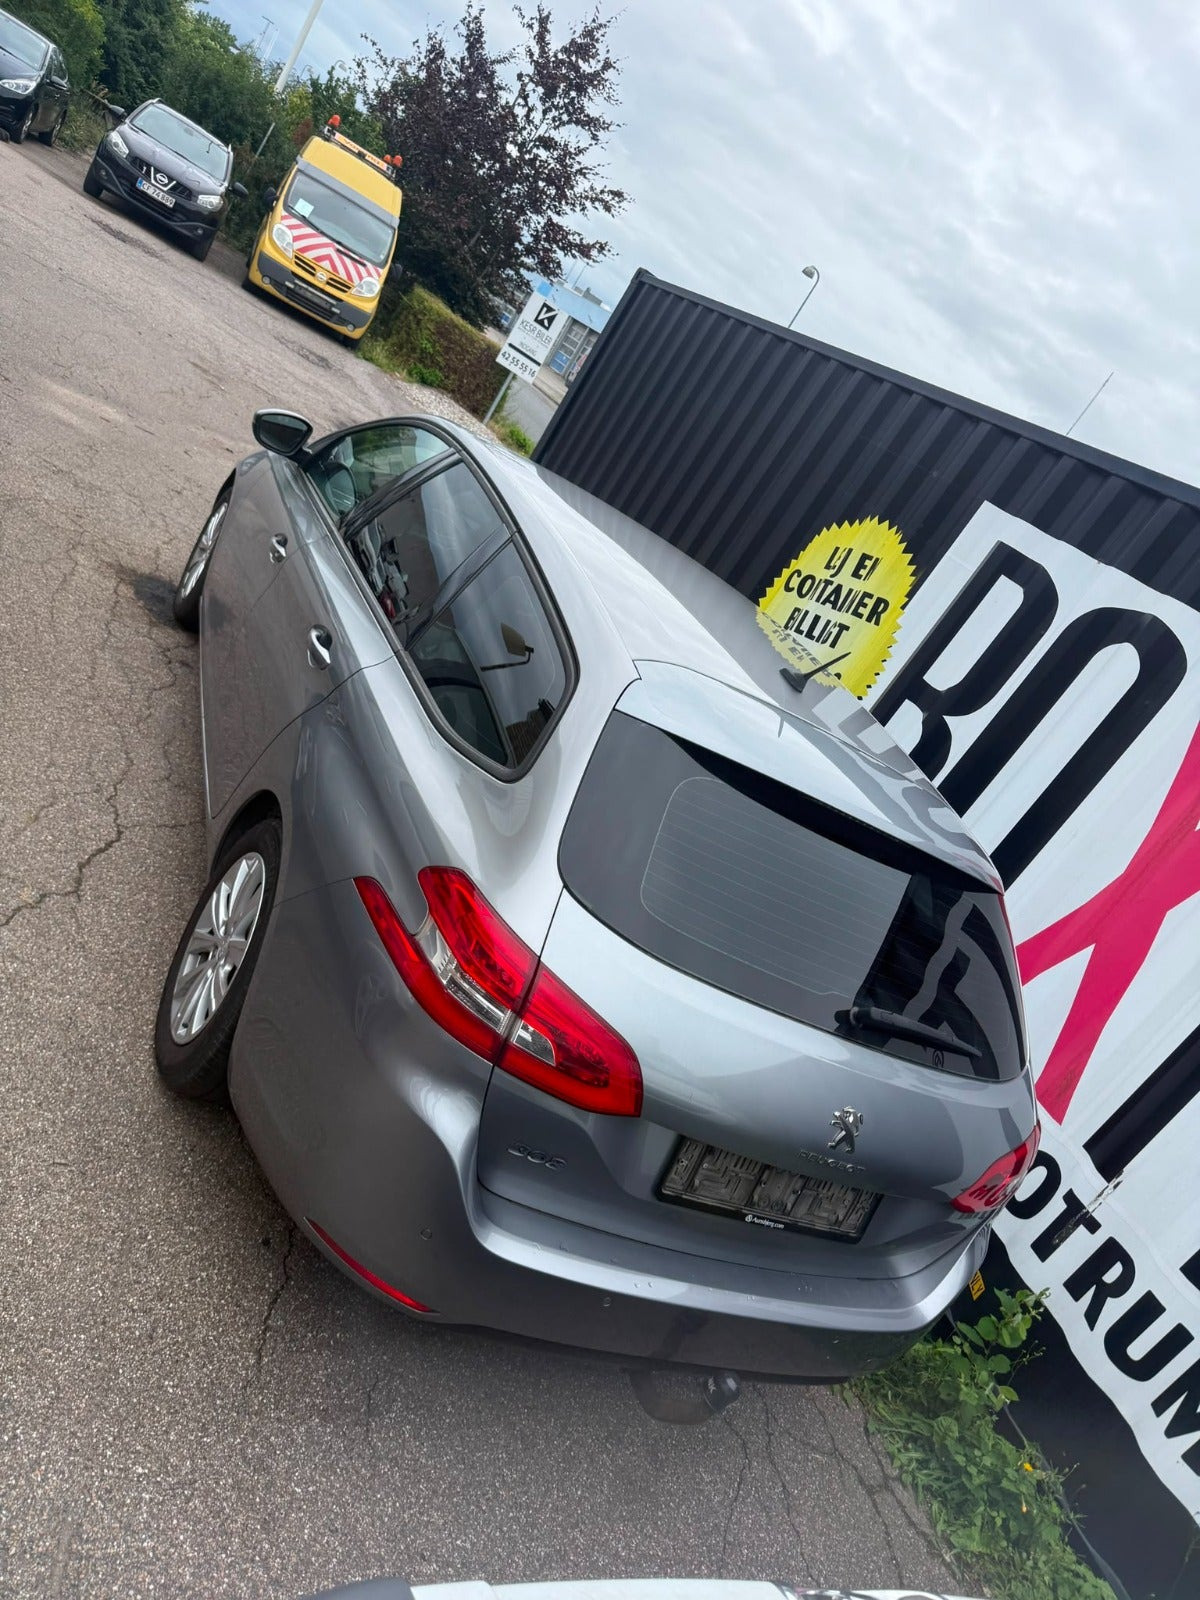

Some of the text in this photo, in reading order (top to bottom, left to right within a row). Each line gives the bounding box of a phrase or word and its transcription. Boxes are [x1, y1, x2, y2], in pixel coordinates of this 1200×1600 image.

[501, 351, 537, 378] 42 55 55 16
